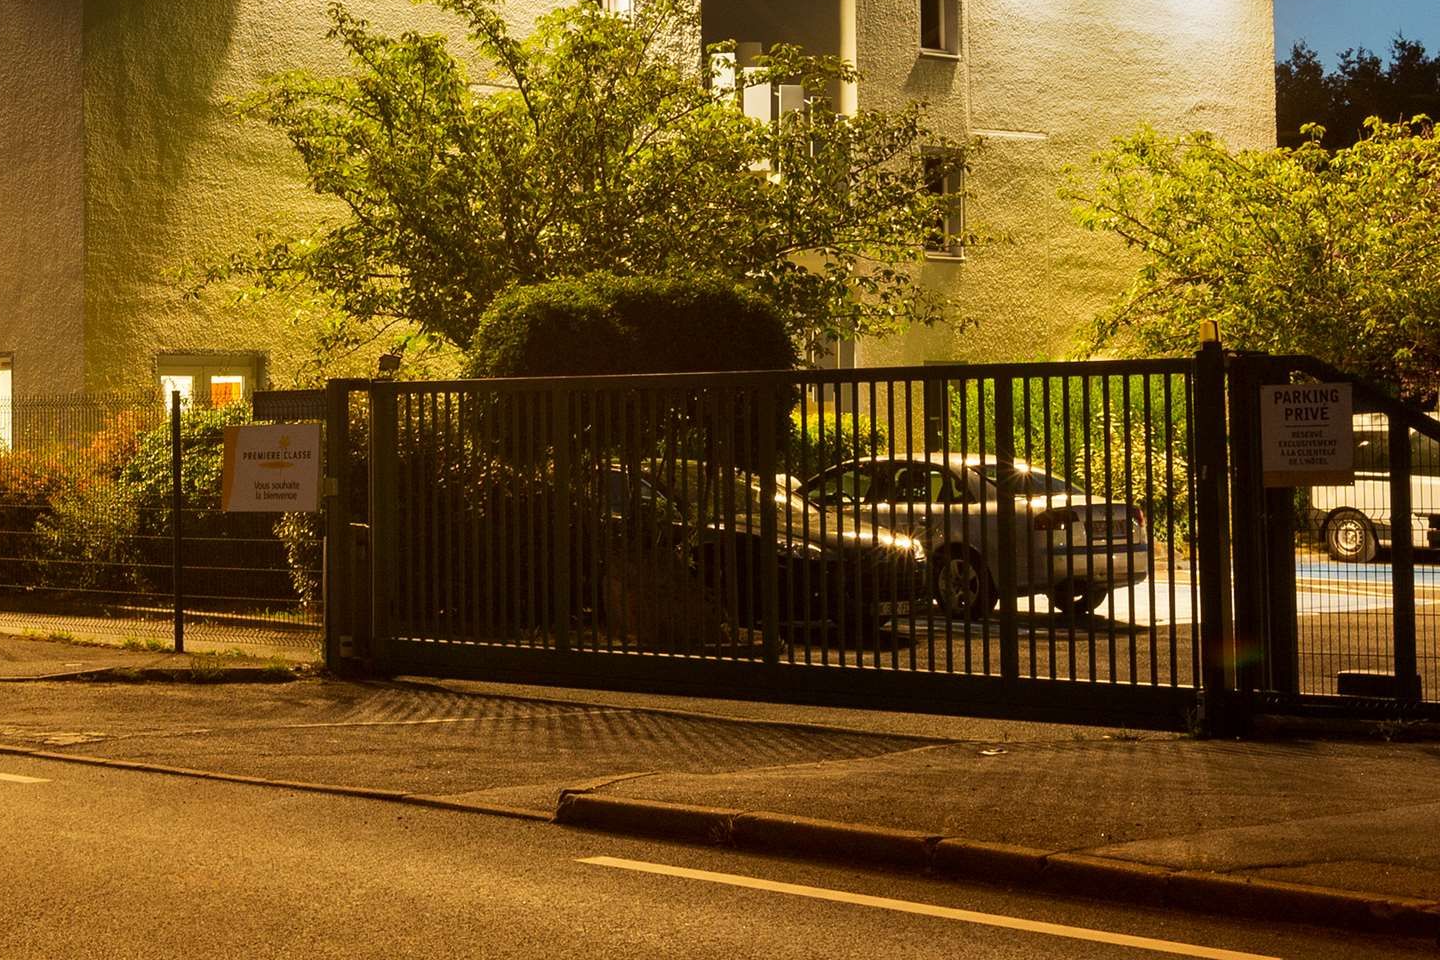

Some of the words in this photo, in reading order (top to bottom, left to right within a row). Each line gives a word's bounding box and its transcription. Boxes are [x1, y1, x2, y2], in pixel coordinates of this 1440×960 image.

[1274, 389, 1339, 405] PARKING
[1284, 403, 1330, 421] PRIVÉ
[243, 451, 280, 460] PREMIERE
[284, 450, 312, 460] CLASSE
